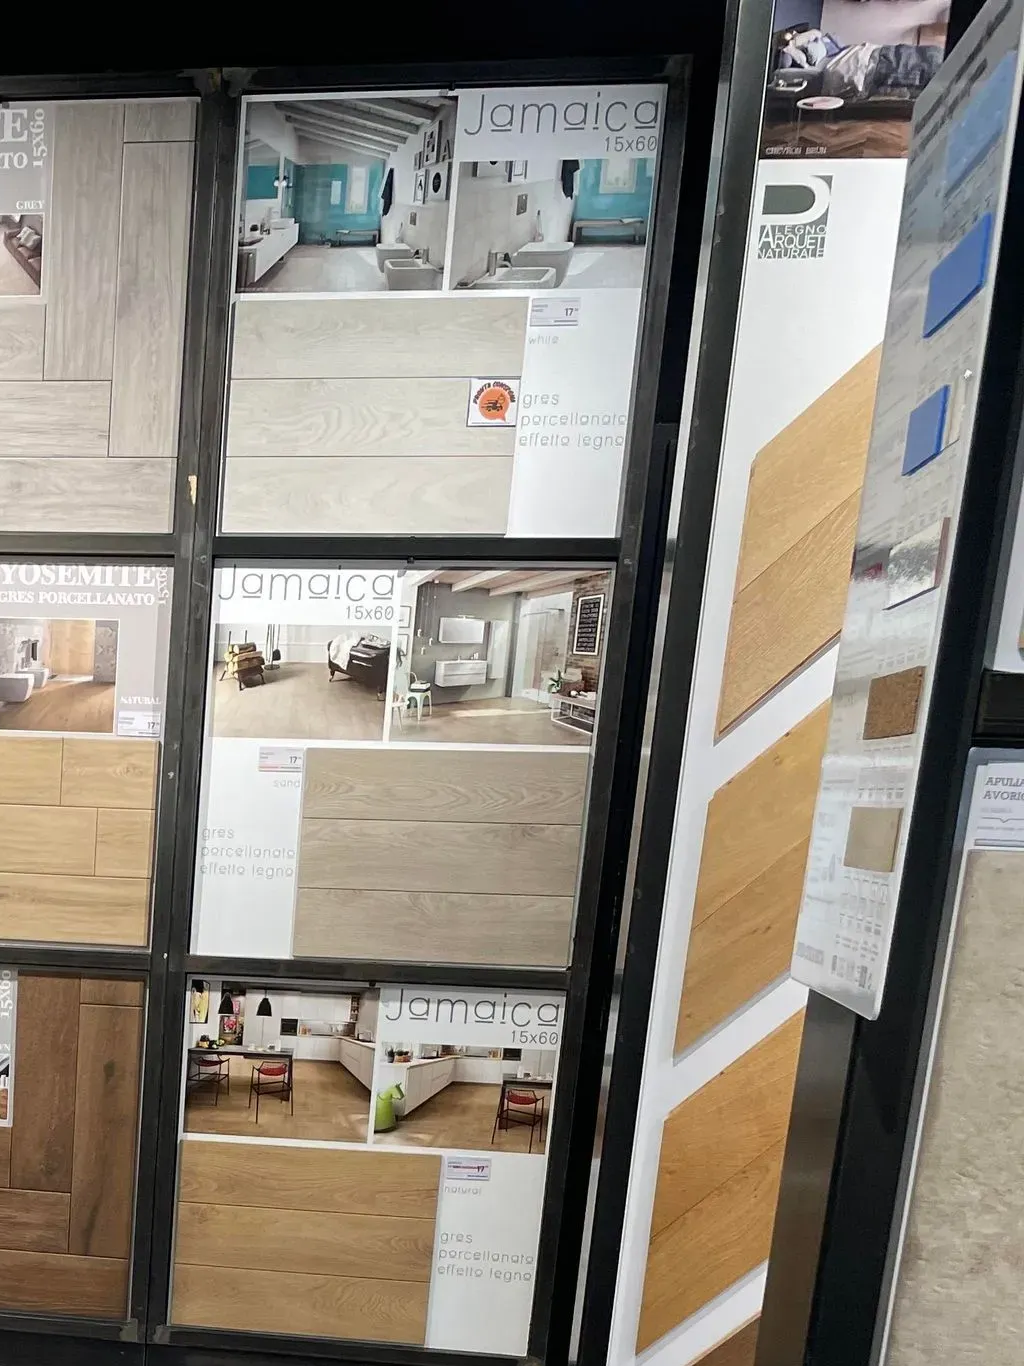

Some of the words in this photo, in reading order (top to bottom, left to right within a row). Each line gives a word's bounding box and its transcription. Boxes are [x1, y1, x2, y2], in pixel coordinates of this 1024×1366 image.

[464, 91, 659, 136] Jamaica
[604, 135, 658, 152] 15x60
[757, 248, 824, 259] NATURALE
[565, 307, 574, 317] 17
[522, 392, 560, 409] gres
[0, 564, 156, 588] YOSEMITE
[218, 563, 395, 602] Jamaica
[38, 591, 156, 606] PORCELLANATO
[345, 605, 394, 620] 15x60
[201, 826, 235, 841] gres
[385, 988, 560, 1028] Jamaica
[510, 1030, 559, 1046] 15x60
[440, 1231, 473, 1244] gres
